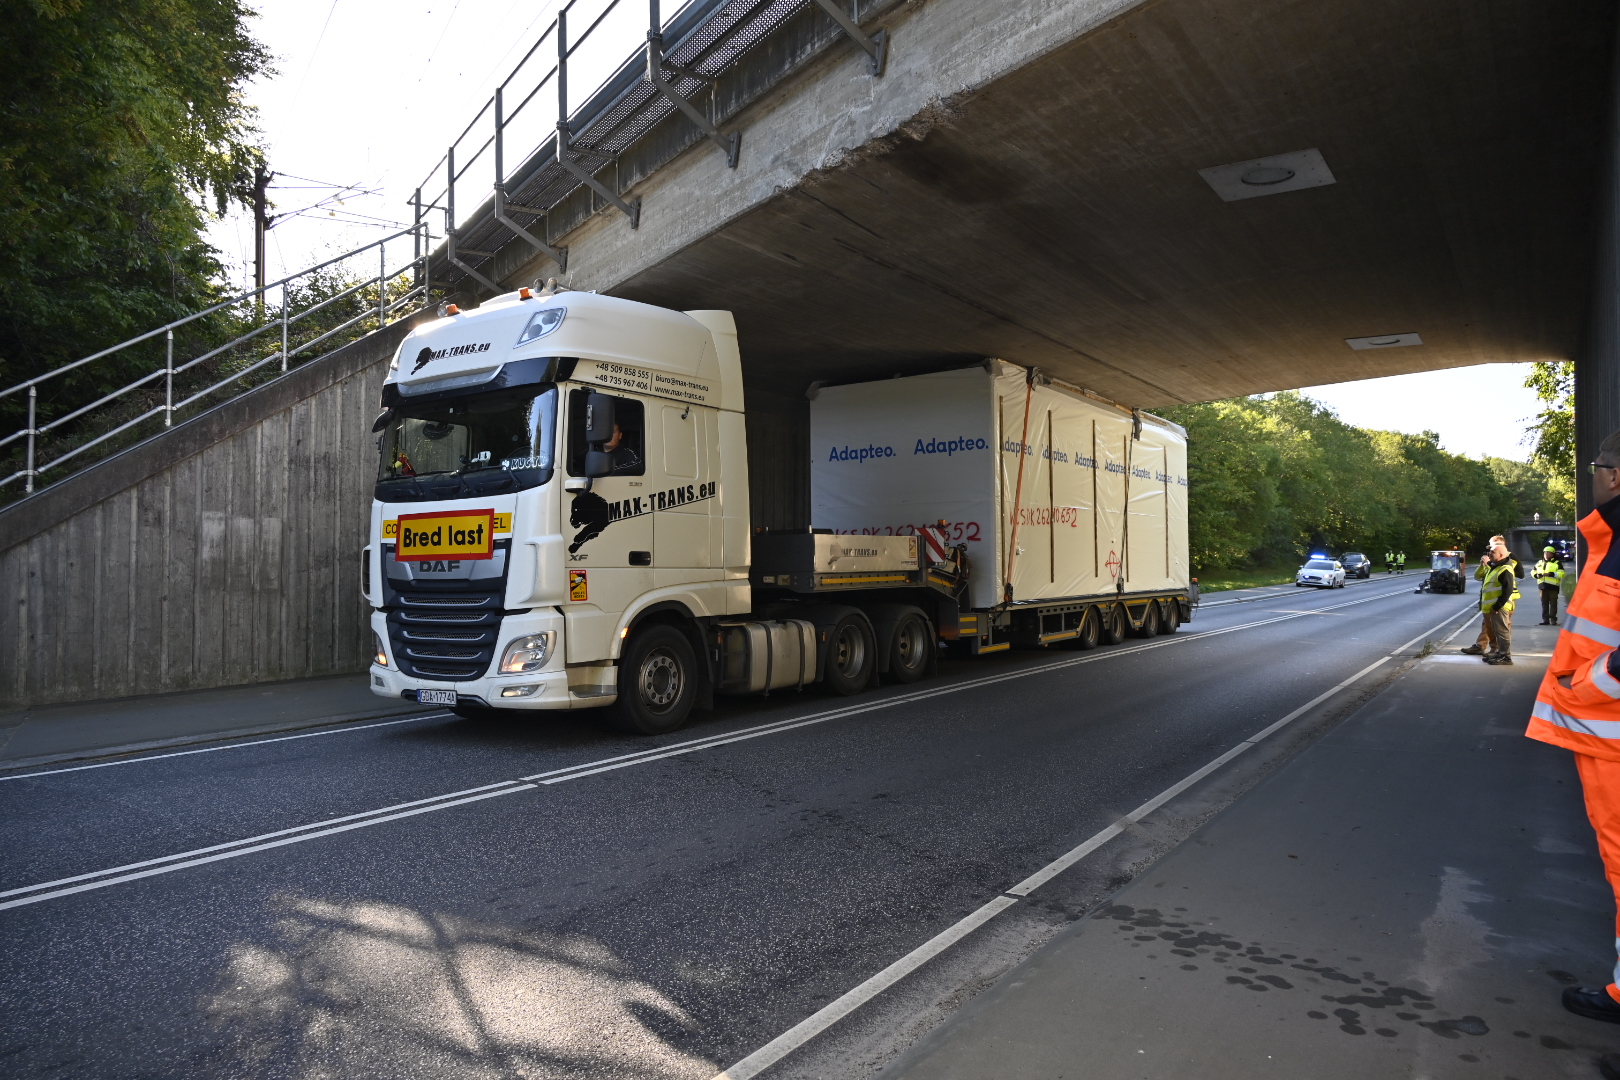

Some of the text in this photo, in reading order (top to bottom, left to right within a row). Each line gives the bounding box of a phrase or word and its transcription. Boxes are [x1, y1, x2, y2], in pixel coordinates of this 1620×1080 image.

[429, 342, 492, 361] MAX-TRANS.eu
[595, 362, 650, 380] +48 509 858 555
[594, 374, 648, 391] +48 735 967 406
[654, 385, 705, 402] www.max-trans.eu
[829, 436, 989, 463] Adapteo. Adapteo.
[1000, 436, 1034, 458] dapteo.
[1042, 443, 1069, 465] Adpteo.
[608, 481, 716, 521] MAX-TRANS.eu
[403, 523, 484, 548] Bred last
[419, 560, 461, 573] DAF
